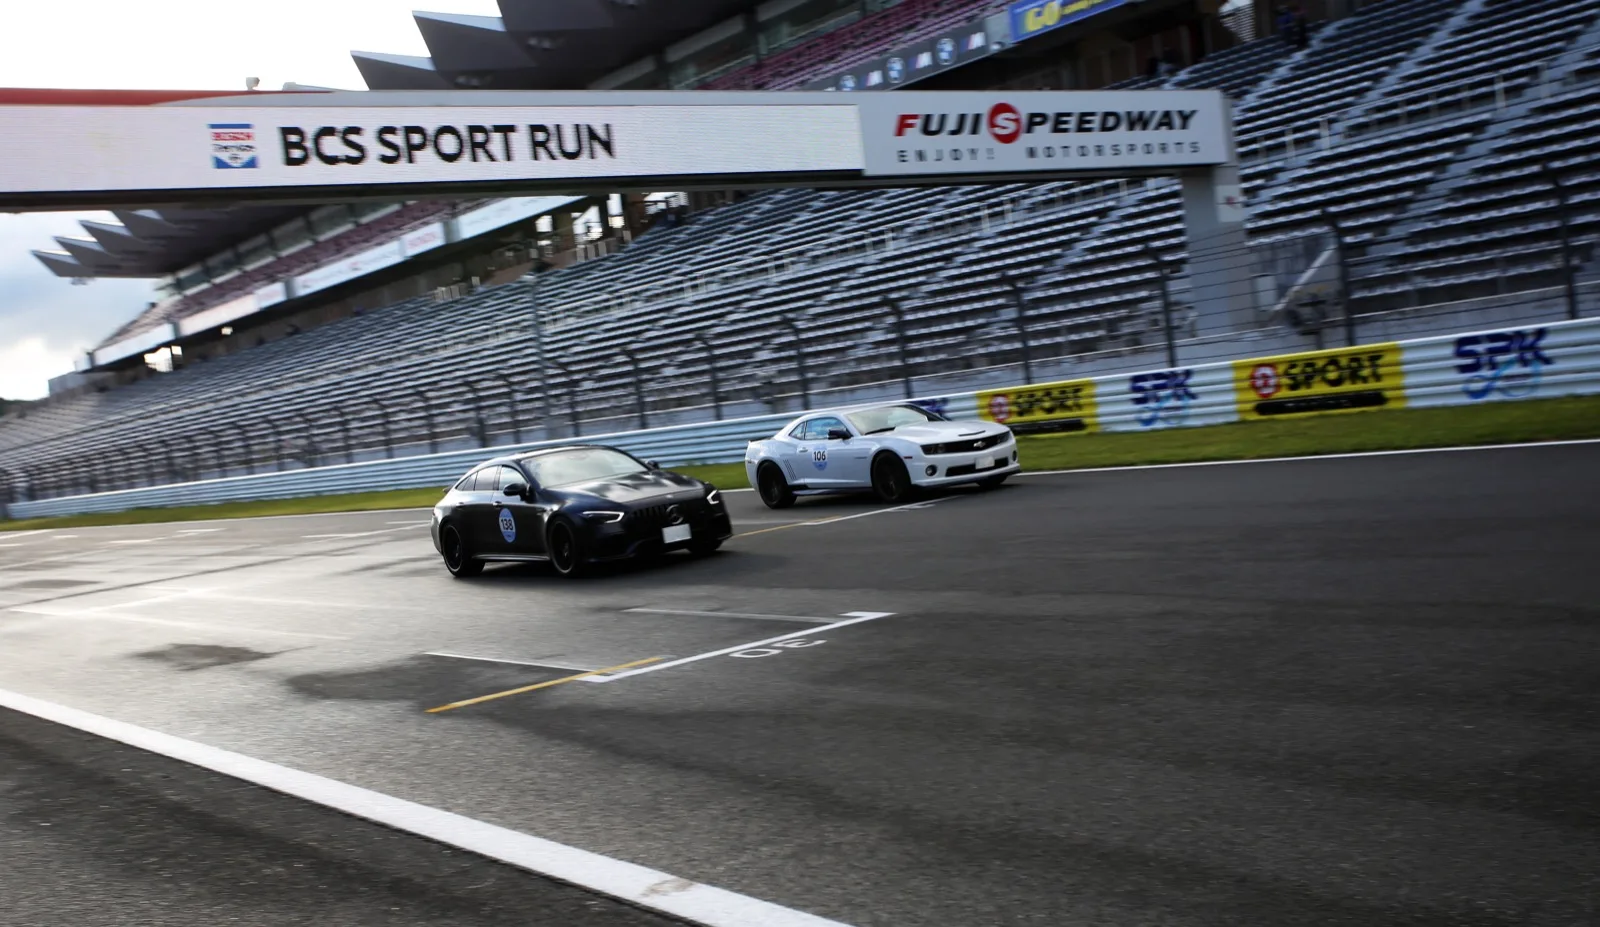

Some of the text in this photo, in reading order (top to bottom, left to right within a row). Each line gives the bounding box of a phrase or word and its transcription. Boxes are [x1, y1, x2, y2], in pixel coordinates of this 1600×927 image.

[893, 105, 1199, 140] FUJI SPEEDWAY
[279, 123, 616, 167] BCS SPORT RUN
[1025, 141, 1200, 159] MOTORSPORTS
[1283, 353, 1385, 391] SPORT
[813, 450, 827, 462] 106
[500, 517, 514, 531] 138
